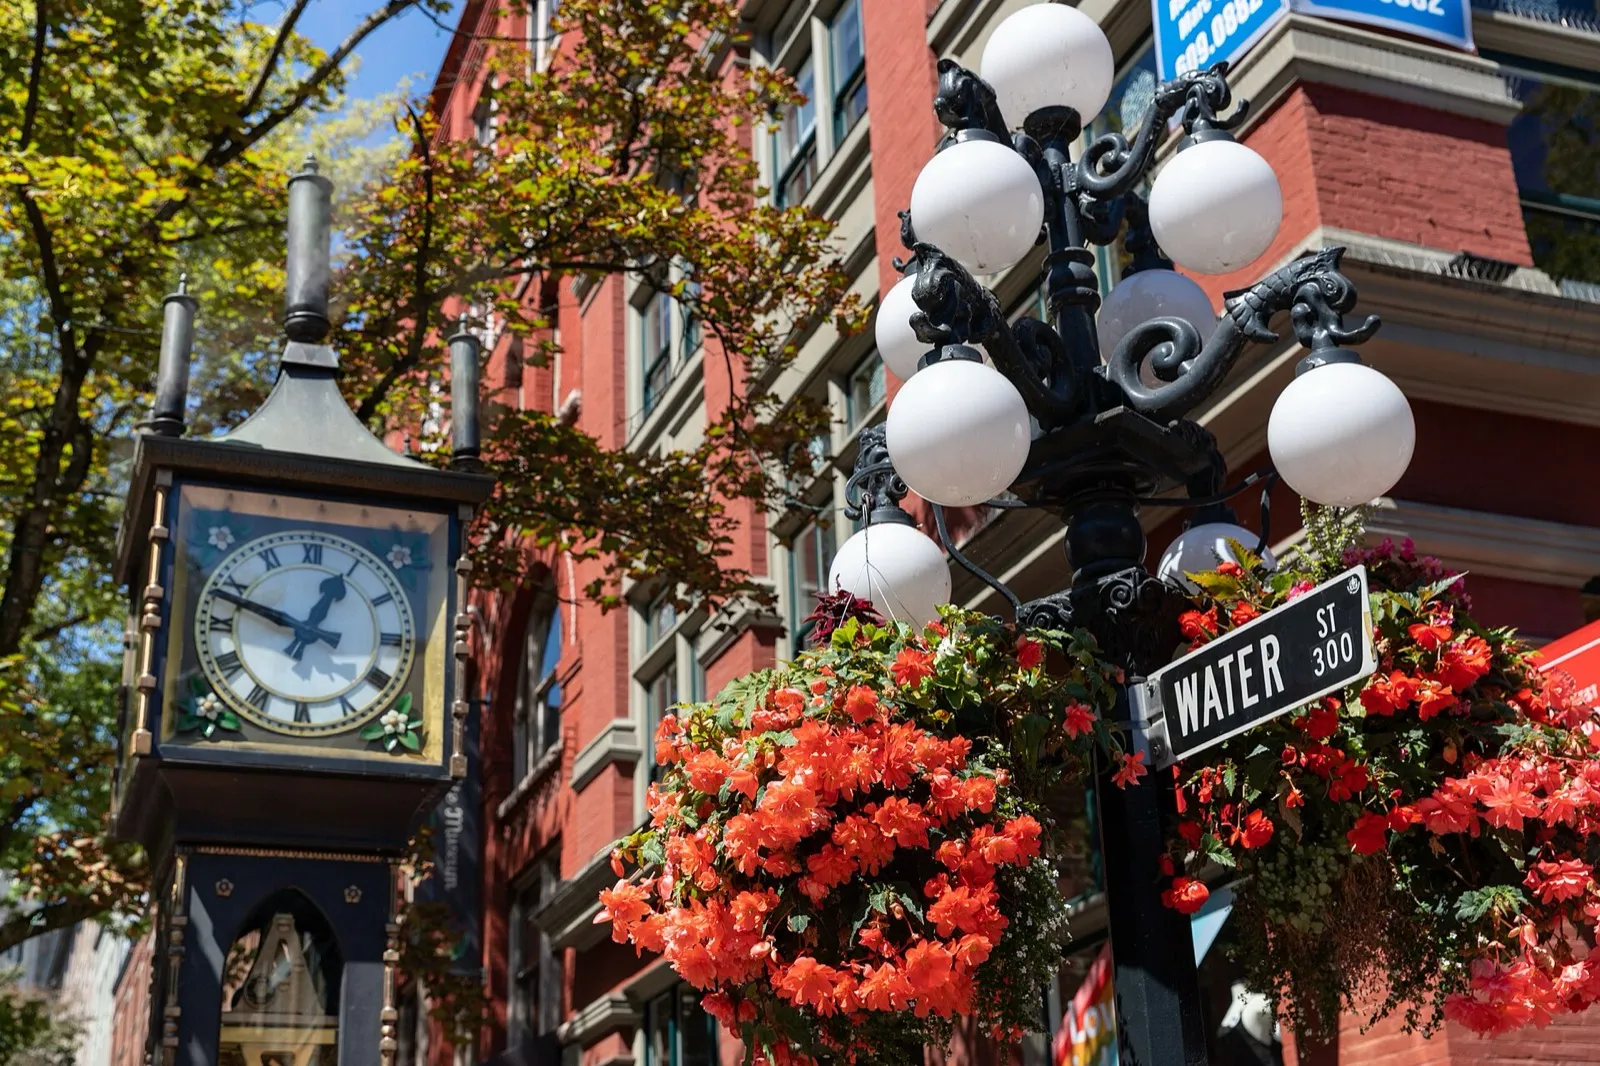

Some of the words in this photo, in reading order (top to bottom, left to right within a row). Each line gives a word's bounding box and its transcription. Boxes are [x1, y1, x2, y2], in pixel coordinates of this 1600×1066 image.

[303, 543, 323, 566] XII
[1316, 602, 1336, 639] ST
[1312, 632, 1354, 677] 300
[1174, 633, 1285, 738] WATER
